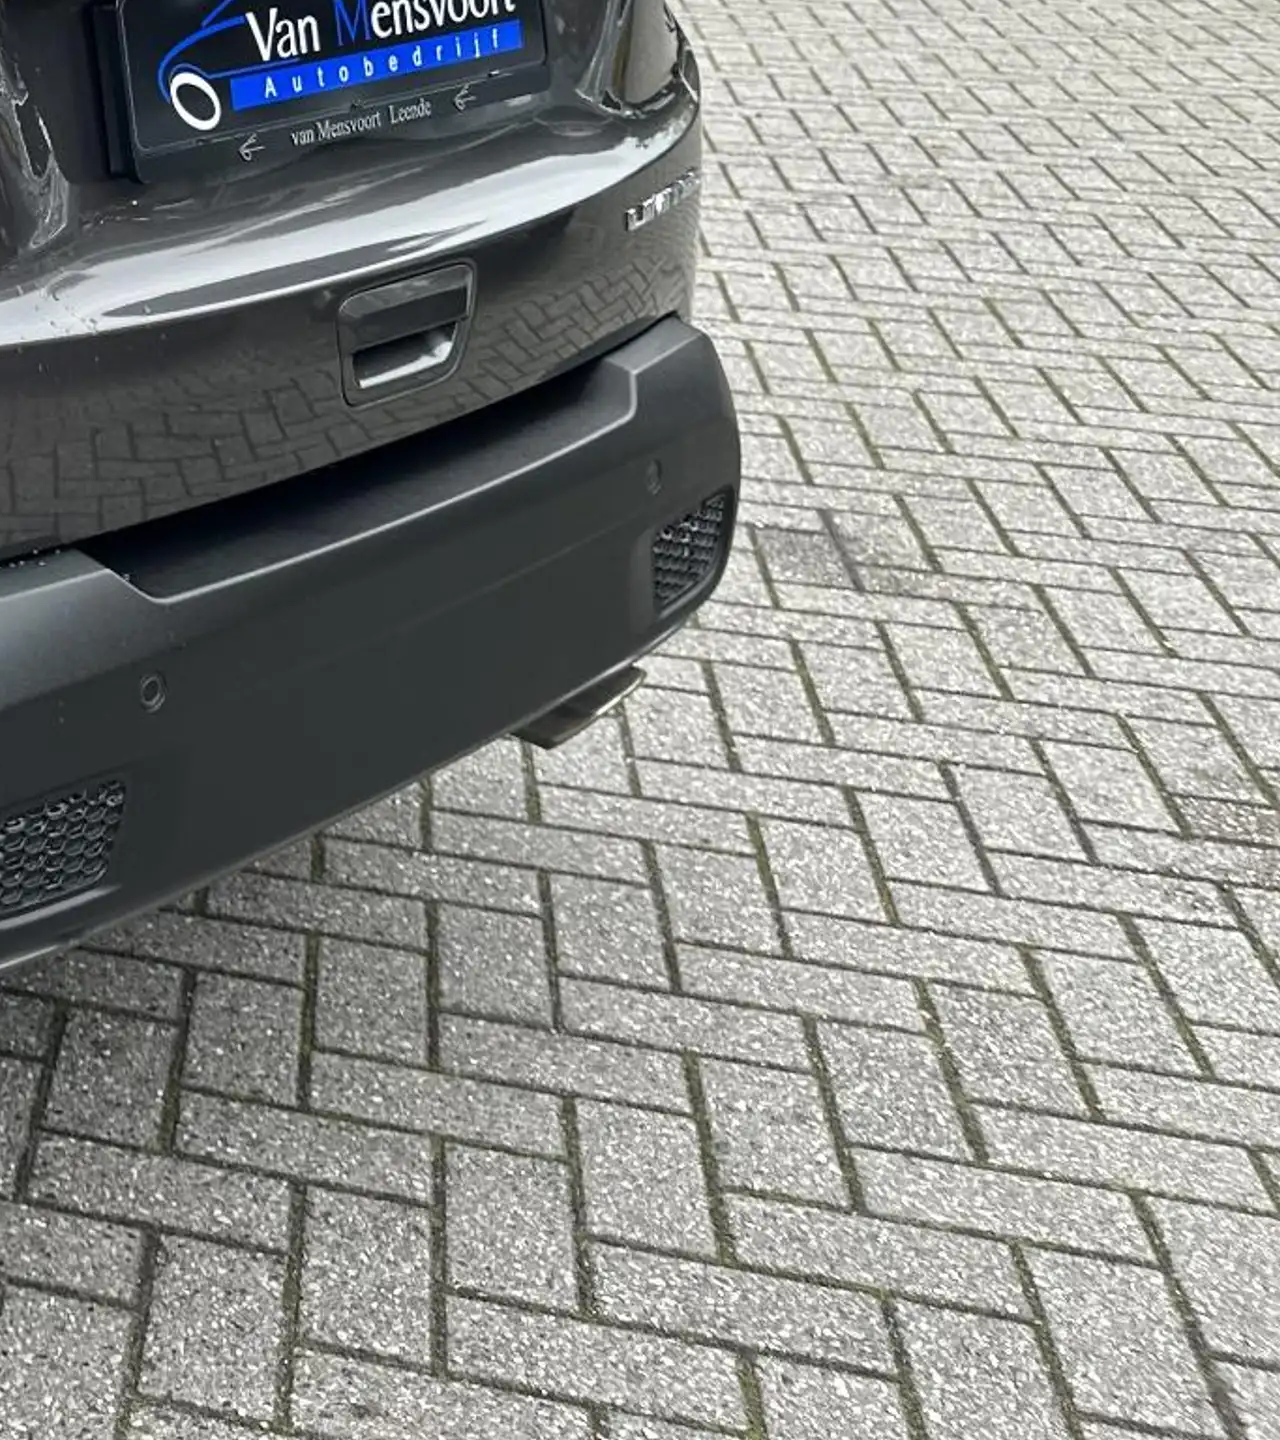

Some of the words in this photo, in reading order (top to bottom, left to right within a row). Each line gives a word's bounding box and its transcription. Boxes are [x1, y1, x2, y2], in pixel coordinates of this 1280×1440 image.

[245, 6, 320, 62] Van
[263, 28, 501, 99] Autobedrijf
[290, 127, 315, 147] van
[315, 111, 382, 142] Mensvoort
[389, 97, 433, 124] Leende
